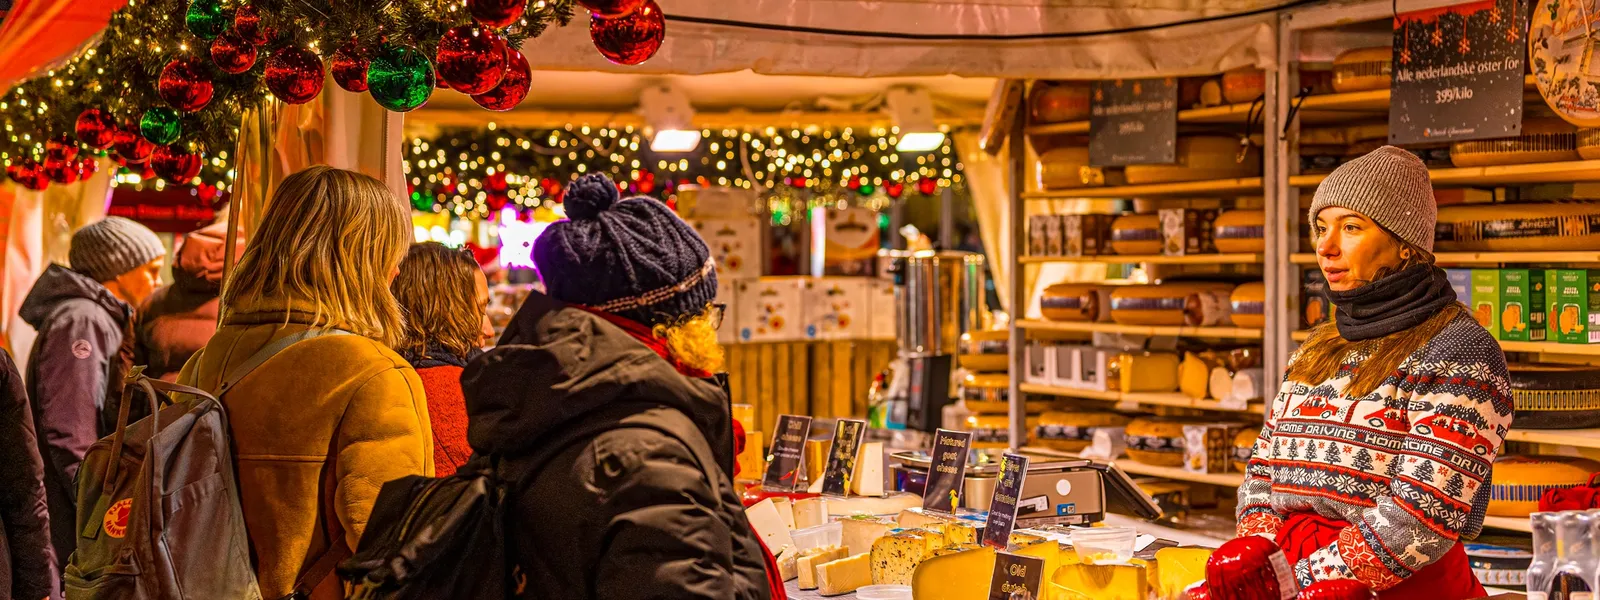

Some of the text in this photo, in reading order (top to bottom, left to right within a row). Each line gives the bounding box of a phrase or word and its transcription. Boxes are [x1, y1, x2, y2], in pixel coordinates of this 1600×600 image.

[1397, 56, 1519, 82] Alle nederlandske oster for
[1435, 86, 1474, 104] 399/kilo
[1278, 423, 1302, 433] HOME
[1305, 424, 1357, 439] DRIVING
[940, 435, 966, 448] Matured
[942, 452, 958, 461] goat
[936, 463, 958, 474] cheese
[1010, 563, 1027, 578] Old
[1001, 580, 1028, 596] dutch
